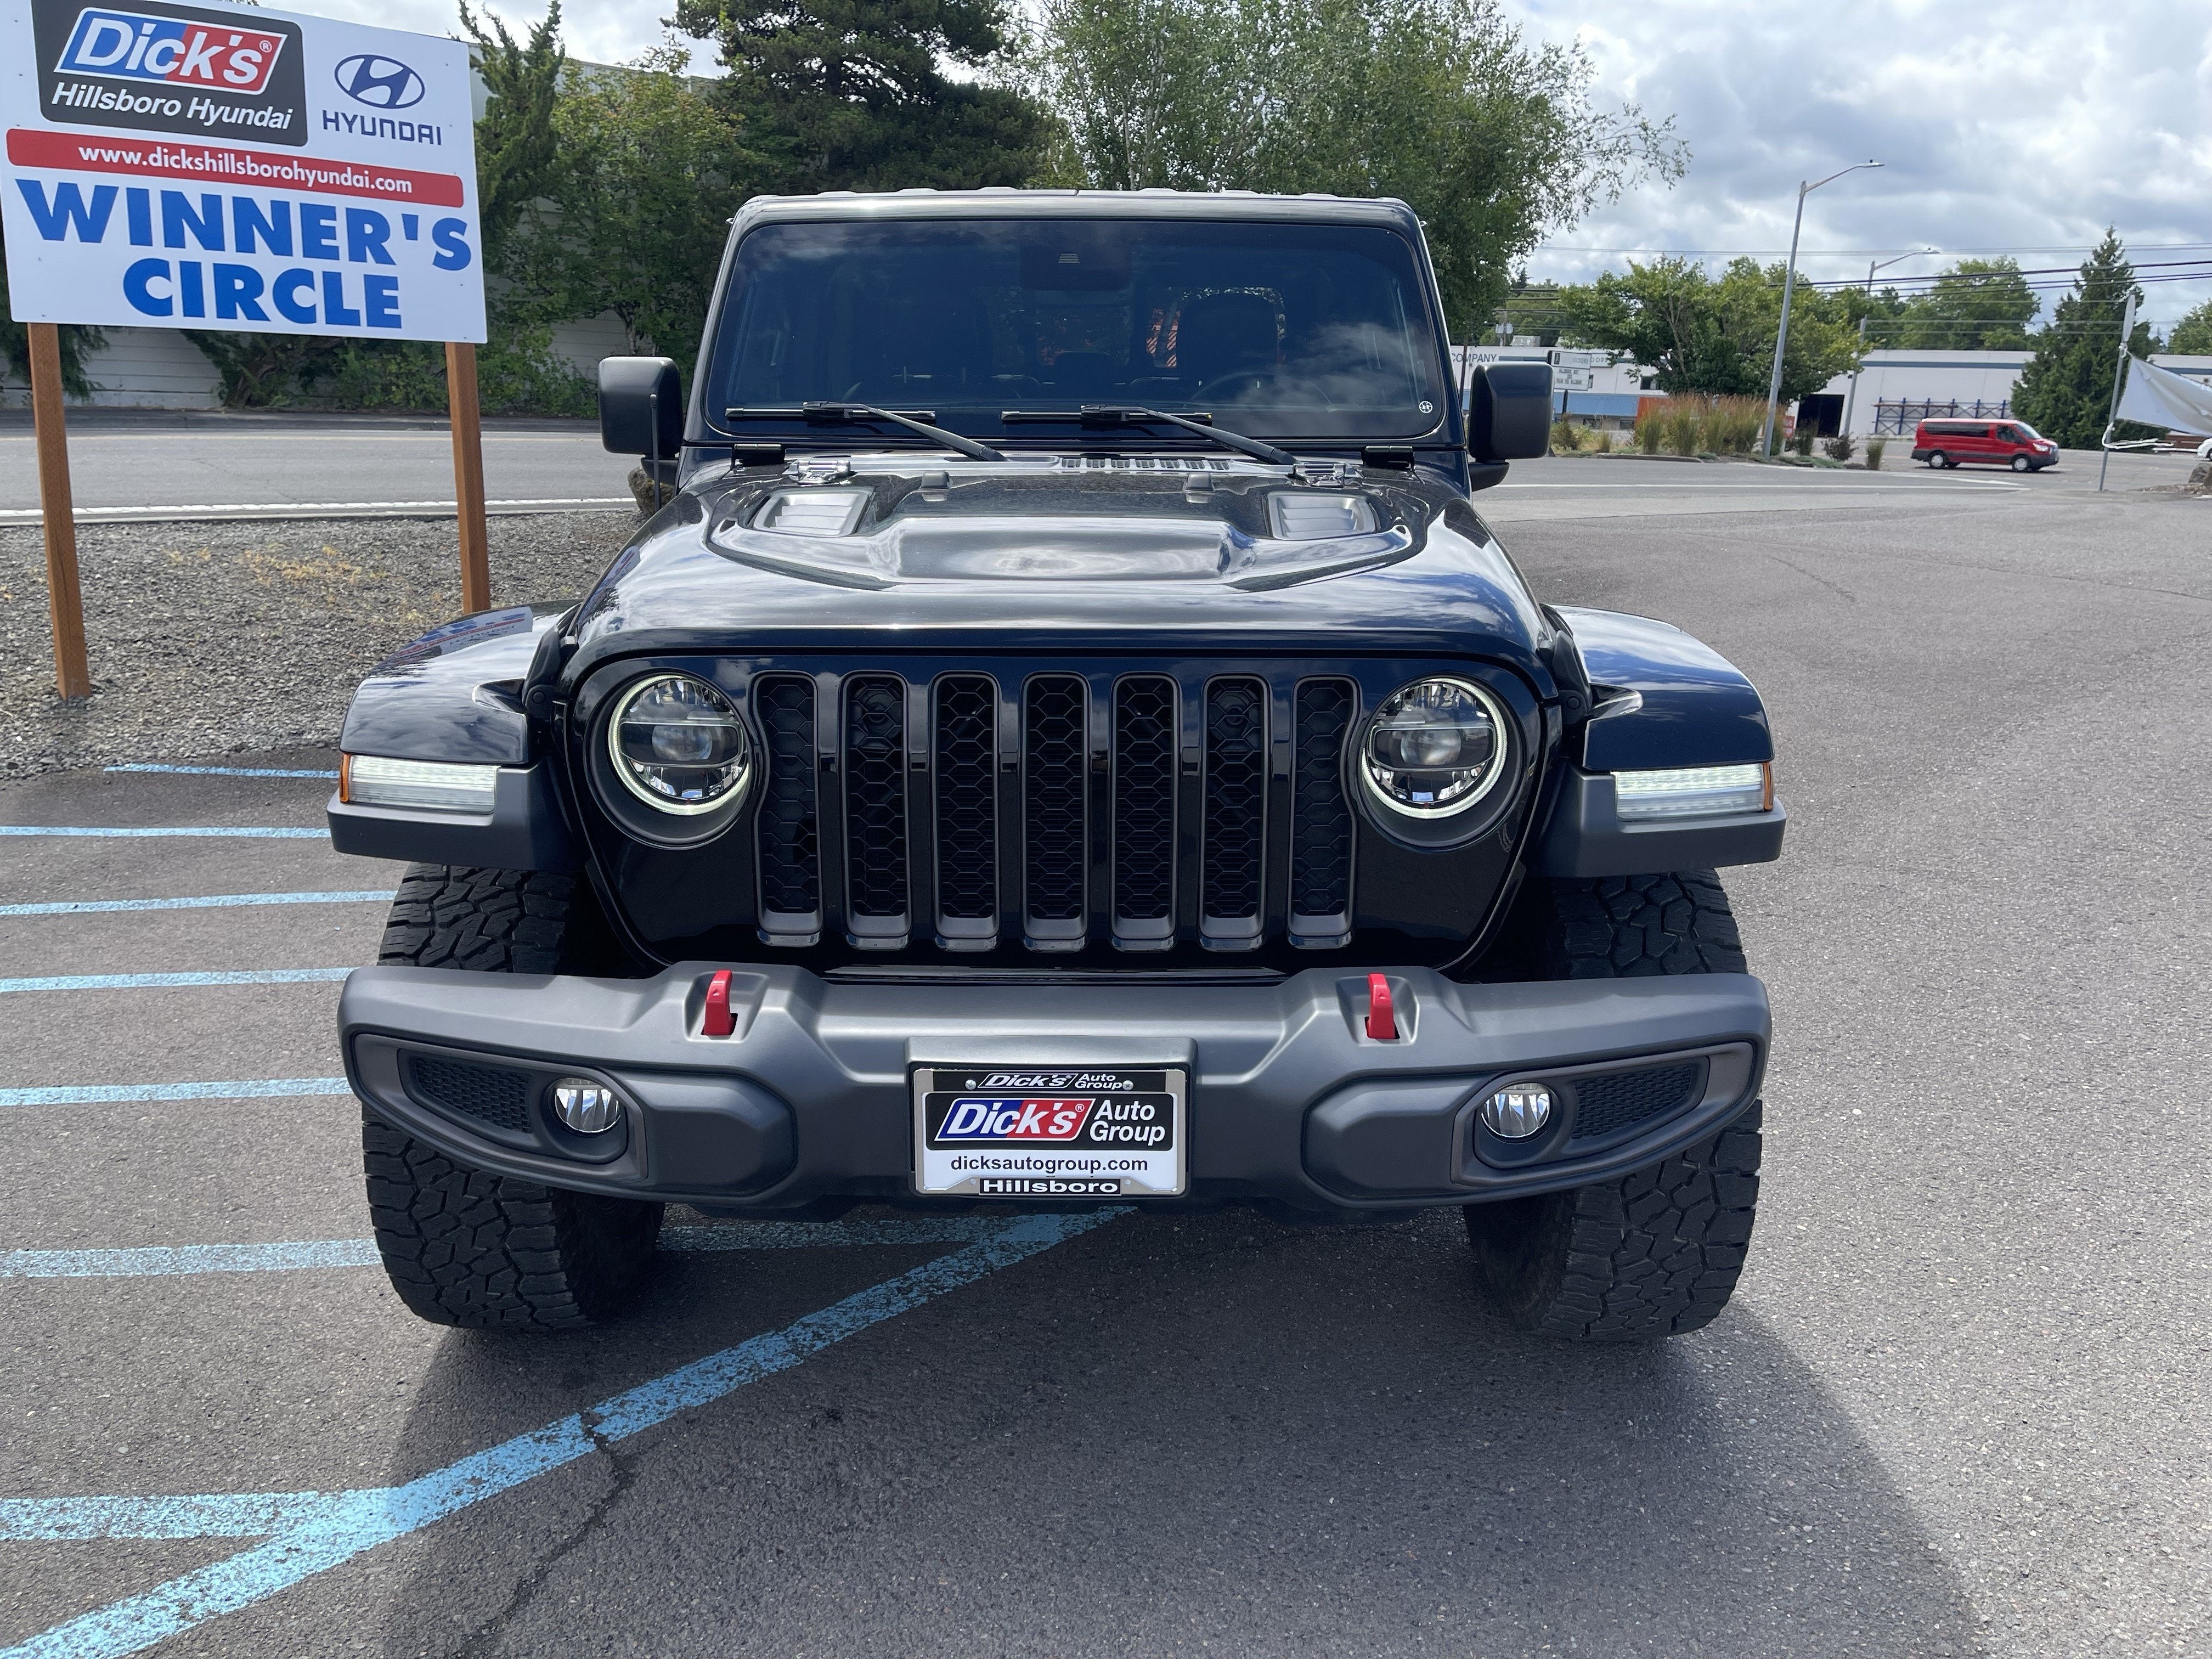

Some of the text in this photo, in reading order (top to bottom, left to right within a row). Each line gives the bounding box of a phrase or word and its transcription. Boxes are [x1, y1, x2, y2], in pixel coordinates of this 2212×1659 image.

[52, 82, 293, 131] Hillsboro Hyundai
[323, 110, 441, 146] HYUNDAI
[78, 145, 413, 194] www.dickshillsborohyundai.com
[15, 179, 472, 271] WINNER'S
[123, 258, 402, 329] CIRCLE
[1075, 1080, 1123, 1090] Group
[1094, 1099, 1155, 1121] Auto
[1090, 1121, 1165, 1146] Group
[951, 1156, 1148, 1173] dicksautogroup.com
[984, 1180, 1118, 1192] Hillsboro
